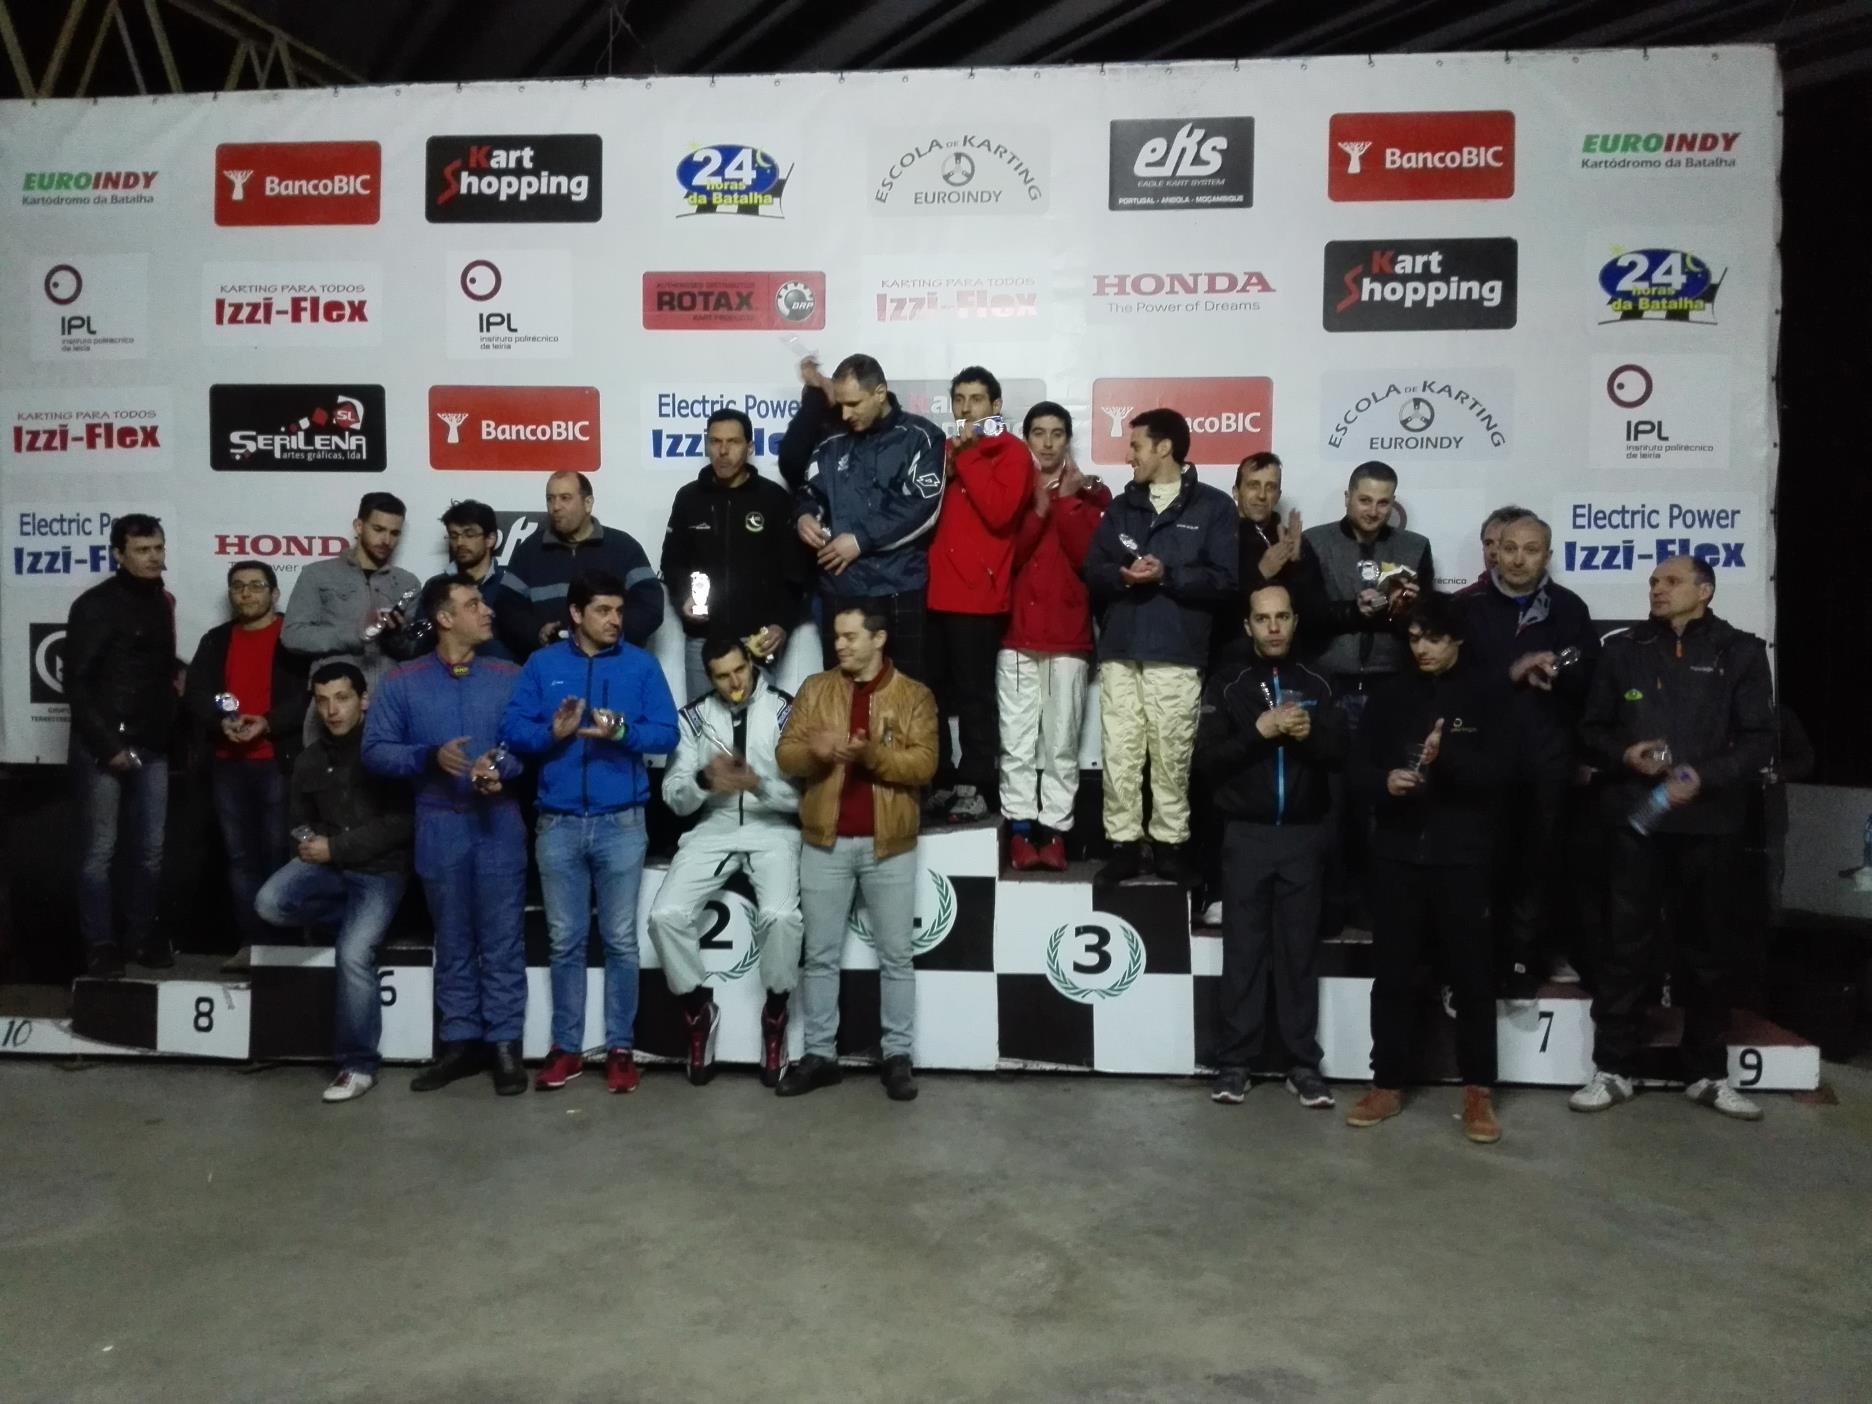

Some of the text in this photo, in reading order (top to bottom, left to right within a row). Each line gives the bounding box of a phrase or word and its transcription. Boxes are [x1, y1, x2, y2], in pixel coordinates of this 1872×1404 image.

[1582, 132, 1742, 153] EUROINDY
[469, 145, 534, 169] Kart
[691, 148, 757, 186] 24
[1385, 146, 1503, 170] BancoBIC
[1581, 157, 1736, 169] Kartódromo da Batalha
[874, 139, 943, 203] ESCOLA
[962, 135, 1042, 201] KARTING
[22, 171, 159, 191] EUROINDY
[265, 175, 371, 197] BancoBIC
[436, 159, 589, 204] Shopping
[1191, 178, 1225, 187] SYSTEM
[93, 196, 107, 205] da
[110, 194, 154, 205] Batalha
[688, 191, 773, 205] da Batalha
[914, 190, 1003, 204] EUROINDY
[1118, 197, 1155, 205] PORTUGAL
[1371, 250, 1443, 274] Kart
[1616, 253, 1687, 291] 24
[220, 284, 366, 293] KARTING PARA TODOS
[881, 278, 1036, 289] KARTING PARA TODOS
[1092, 271, 1277, 296] HONDA
[1336, 264, 1503, 313] Shopping
[215, 296, 368, 325] Izzi-Flex
[656, 291, 755, 311] ROTAX
[1107, 300, 1261, 313] The Power of Dreams
[1611, 297, 1705, 311] da Batalha
[61, 315, 96, 335] IPL
[479, 313, 518, 333] IPL
[17, 410, 157, 421] KARTING PARA TODOS
[745, 394, 802, 418] Powe
[1328, 384, 1402, 448] ESCOLA
[1422, 380, 1506, 448] KARTING
[481, 420, 590, 441] BancoBIC
[1185, 412, 1261, 433] coBIC
[1626, 420, 1669, 441] IPL
[13, 422, 161, 453] Izzi-Flex
[1369, 436, 1464, 450] EUROINDY
[282, 452, 304, 460] artes
[19, 512, 92, 536] Electric
[1572, 503, 1741, 529] Electric Power
[214, 534, 350, 556] HOND
[699, 900, 733, 950] 2
[1072, 925, 1113, 975] 3
[194, 996, 214, 1033] 8
[1, 1020, 32, 1048] 10
[1537, 1011, 1554, 1053] 7
[1739, 1048, 1763, 1086] 9
